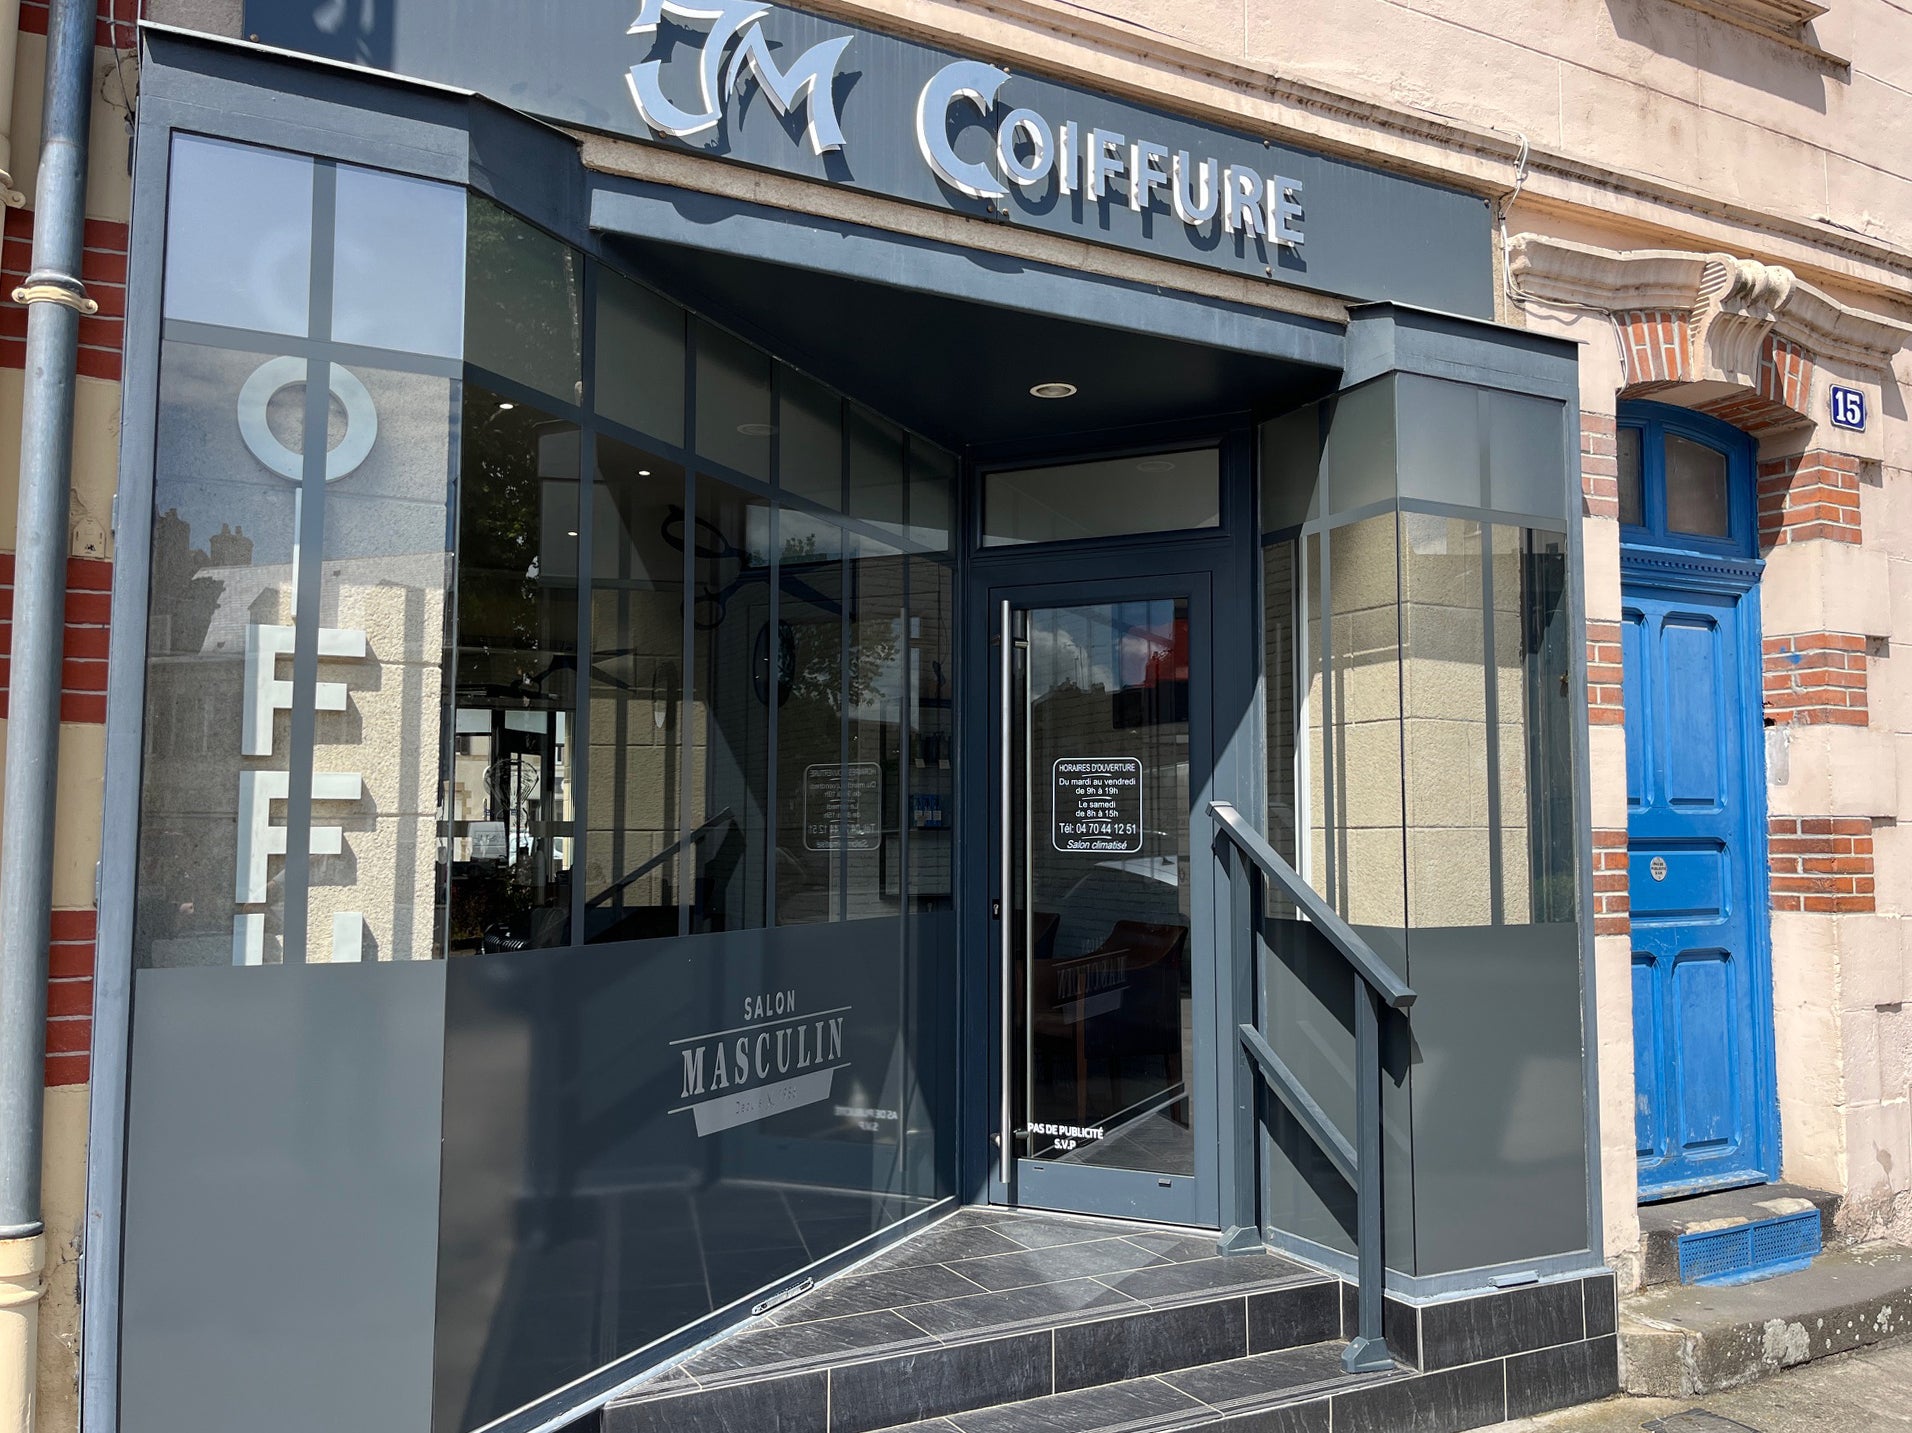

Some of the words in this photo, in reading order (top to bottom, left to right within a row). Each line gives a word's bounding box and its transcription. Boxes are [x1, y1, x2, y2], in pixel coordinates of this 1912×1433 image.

[1835, 391, 1861, 424] 15
[1059, 764, 1090, 772] HORAIRES
[1092, 763, 1136, 772] D'OUVERTURE
[1059, 778, 1069, 786] Du
[1059, 823, 1074, 833] Tél:
[1076, 824, 1086, 834] 04
[1088, 824, 1099, 834] 70
[1100, 824, 1111, 834] 44
[1114, 824, 1124, 834] 12
[1126, 824, 1136, 834] 51
[1067, 839, 1090, 849] Salon
[1091, 840, 1128, 849] climatisé
[743, 990, 796, 1021] SALON
[680, 1017, 844, 1099] MASCULIN
[1027, 1122, 1045, 1133] PAS
[1045, 1123, 1058, 1135] DE
[1058, 1125, 1104, 1140] PUBLICITÉ
[1054, 1138, 1077, 1150] S.V.P
